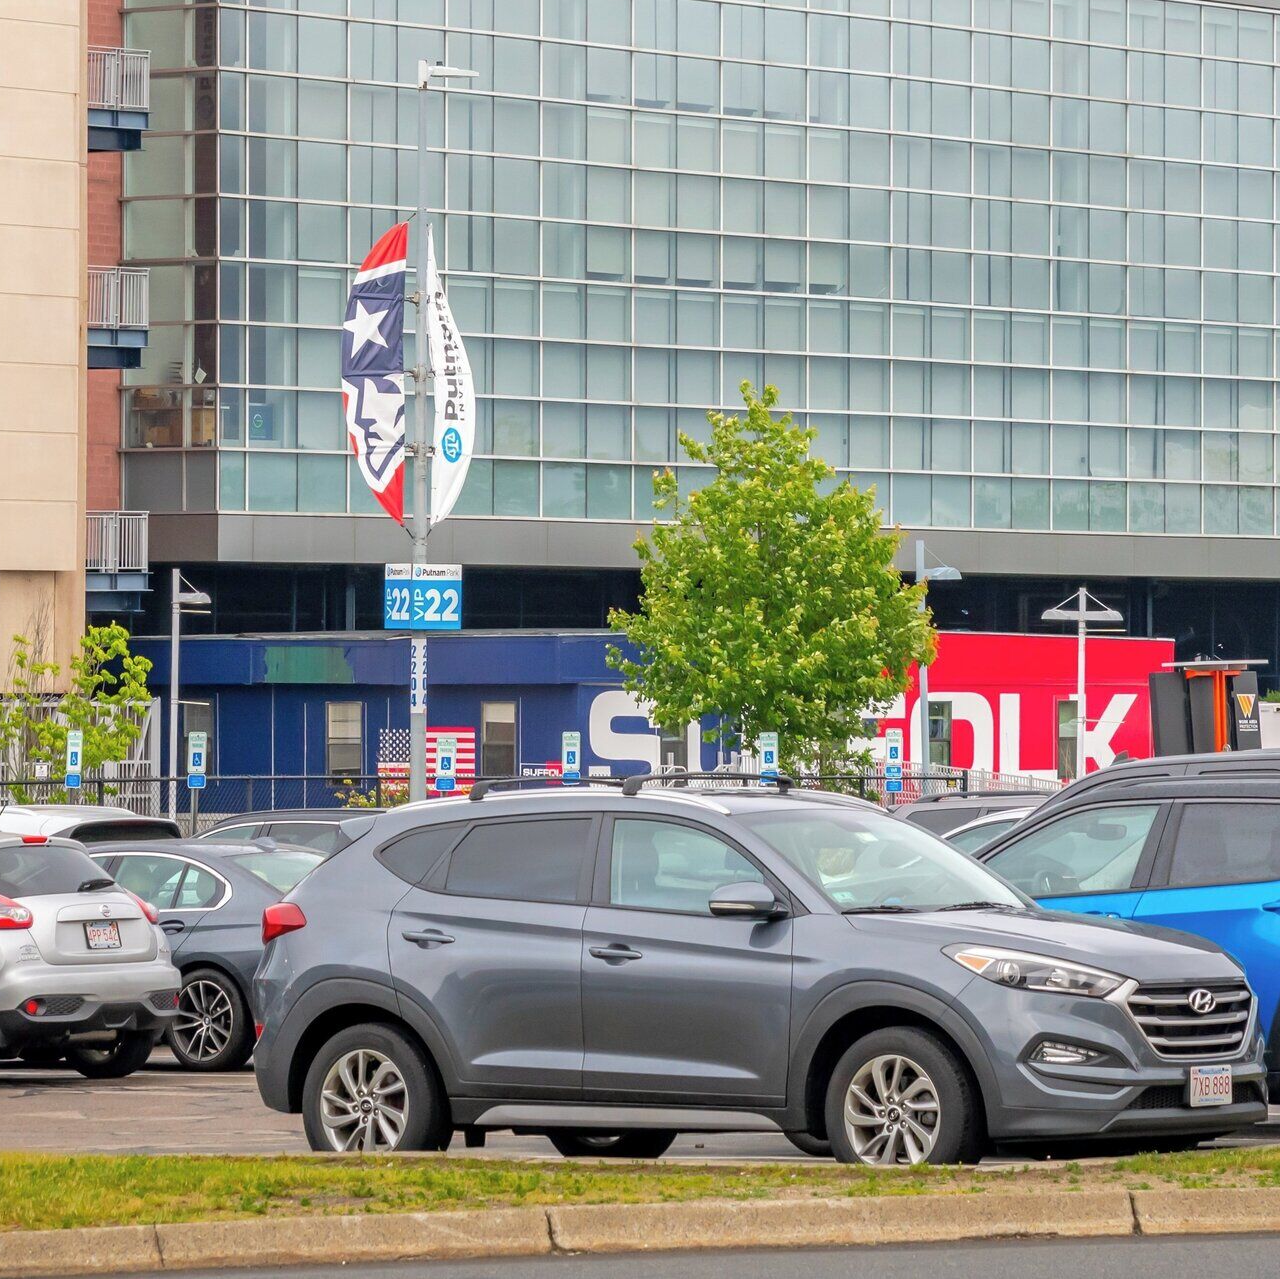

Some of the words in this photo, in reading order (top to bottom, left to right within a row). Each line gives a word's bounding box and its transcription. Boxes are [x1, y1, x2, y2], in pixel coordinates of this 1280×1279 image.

[390, 567, 403, 576] Putnam
[422, 568, 446, 576] Putnam
[446, 568, 459, 576] Park
[391, 587, 410, 621] 22
[413, 588, 425, 621] VIP
[424, 588, 459, 622] 22
[522, 768, 562, 777] SUFFOL
[88, 929, 101, 942] 4PP
[102, 928, 119, 942] 542
[1193, 1076, 1210, 1097] 7XB
[1212, 1075, 1230, 1095] 888
